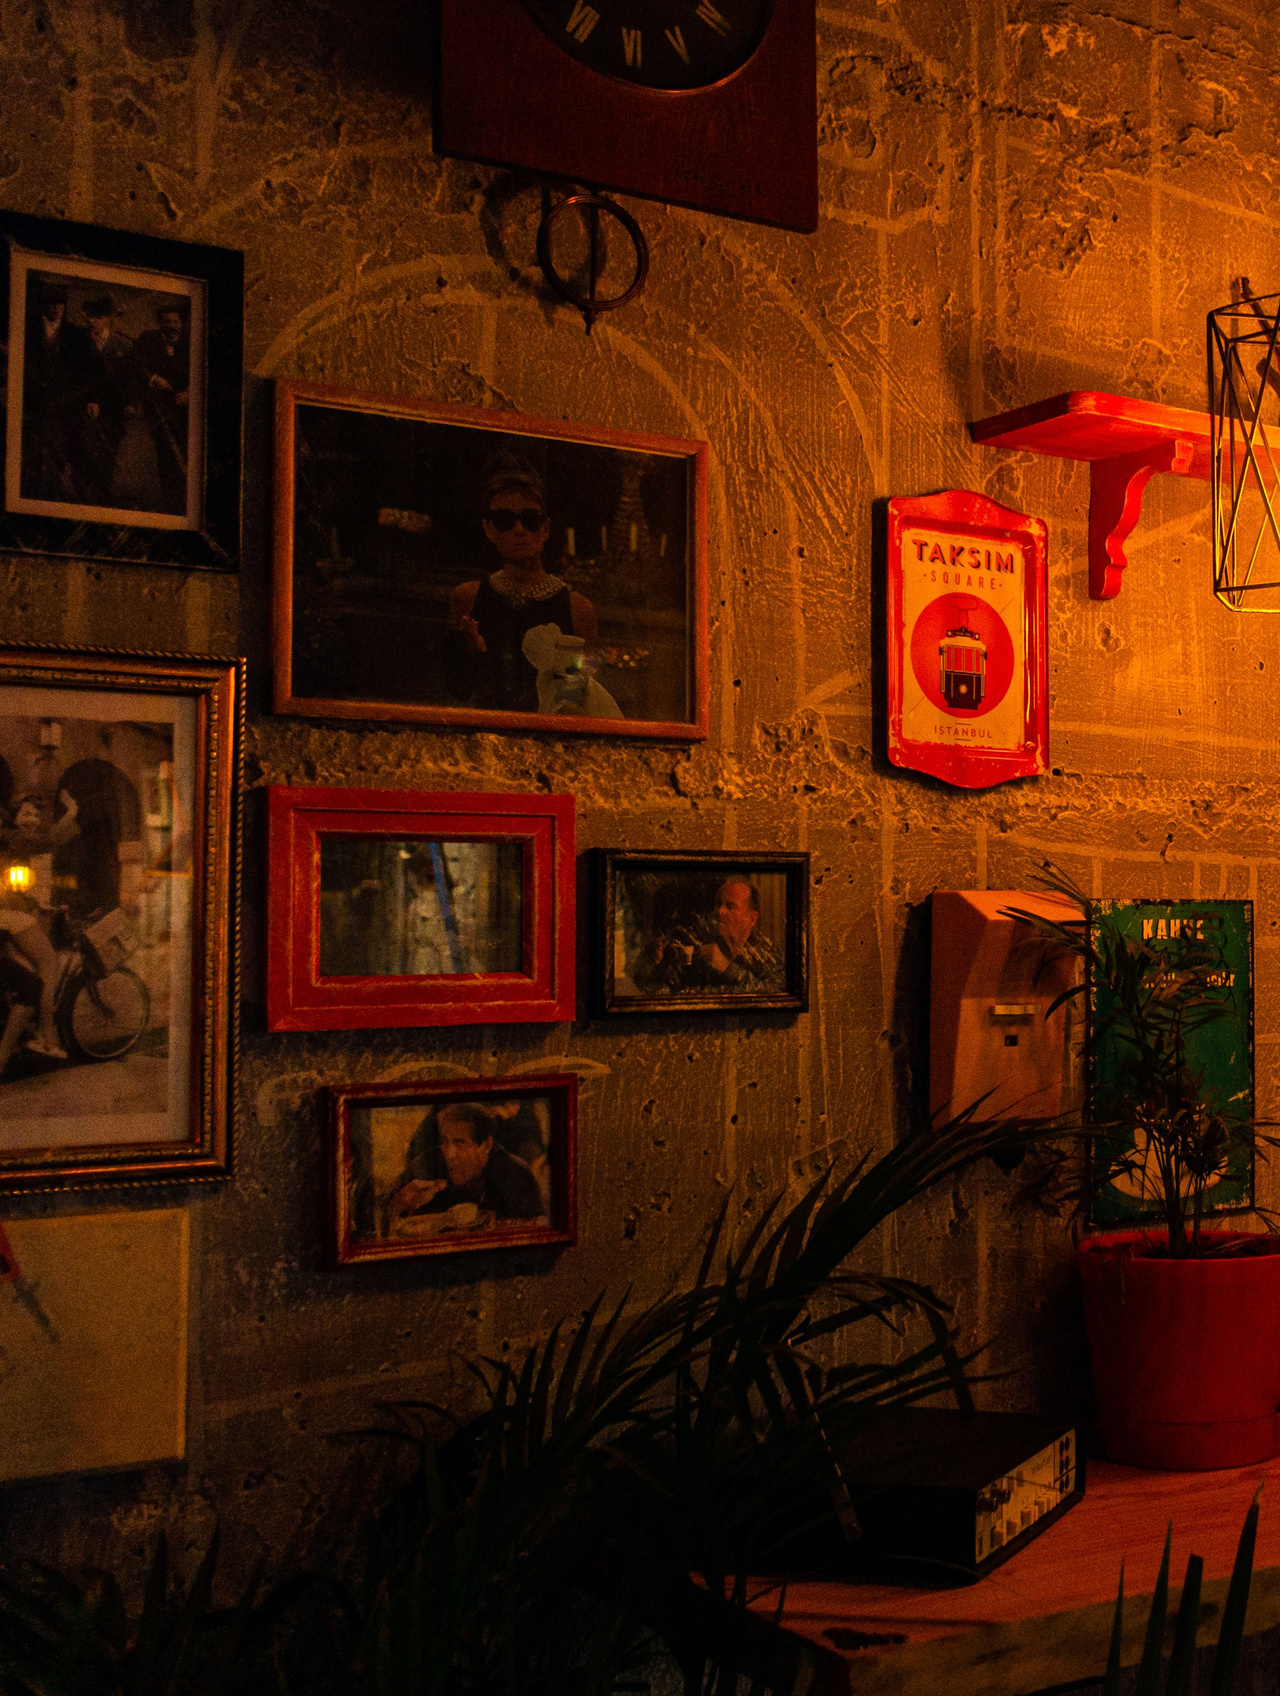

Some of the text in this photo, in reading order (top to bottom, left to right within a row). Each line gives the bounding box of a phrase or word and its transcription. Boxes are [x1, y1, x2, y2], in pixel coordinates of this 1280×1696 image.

[621, 26, 643, 68] VI
[664, 25, 691, 66] V
[912, 539, 1014, 574] TAKSIM
[931, 570, 996, 590] SQUARE
[934, 726, 992, 739] ISTANBUL
